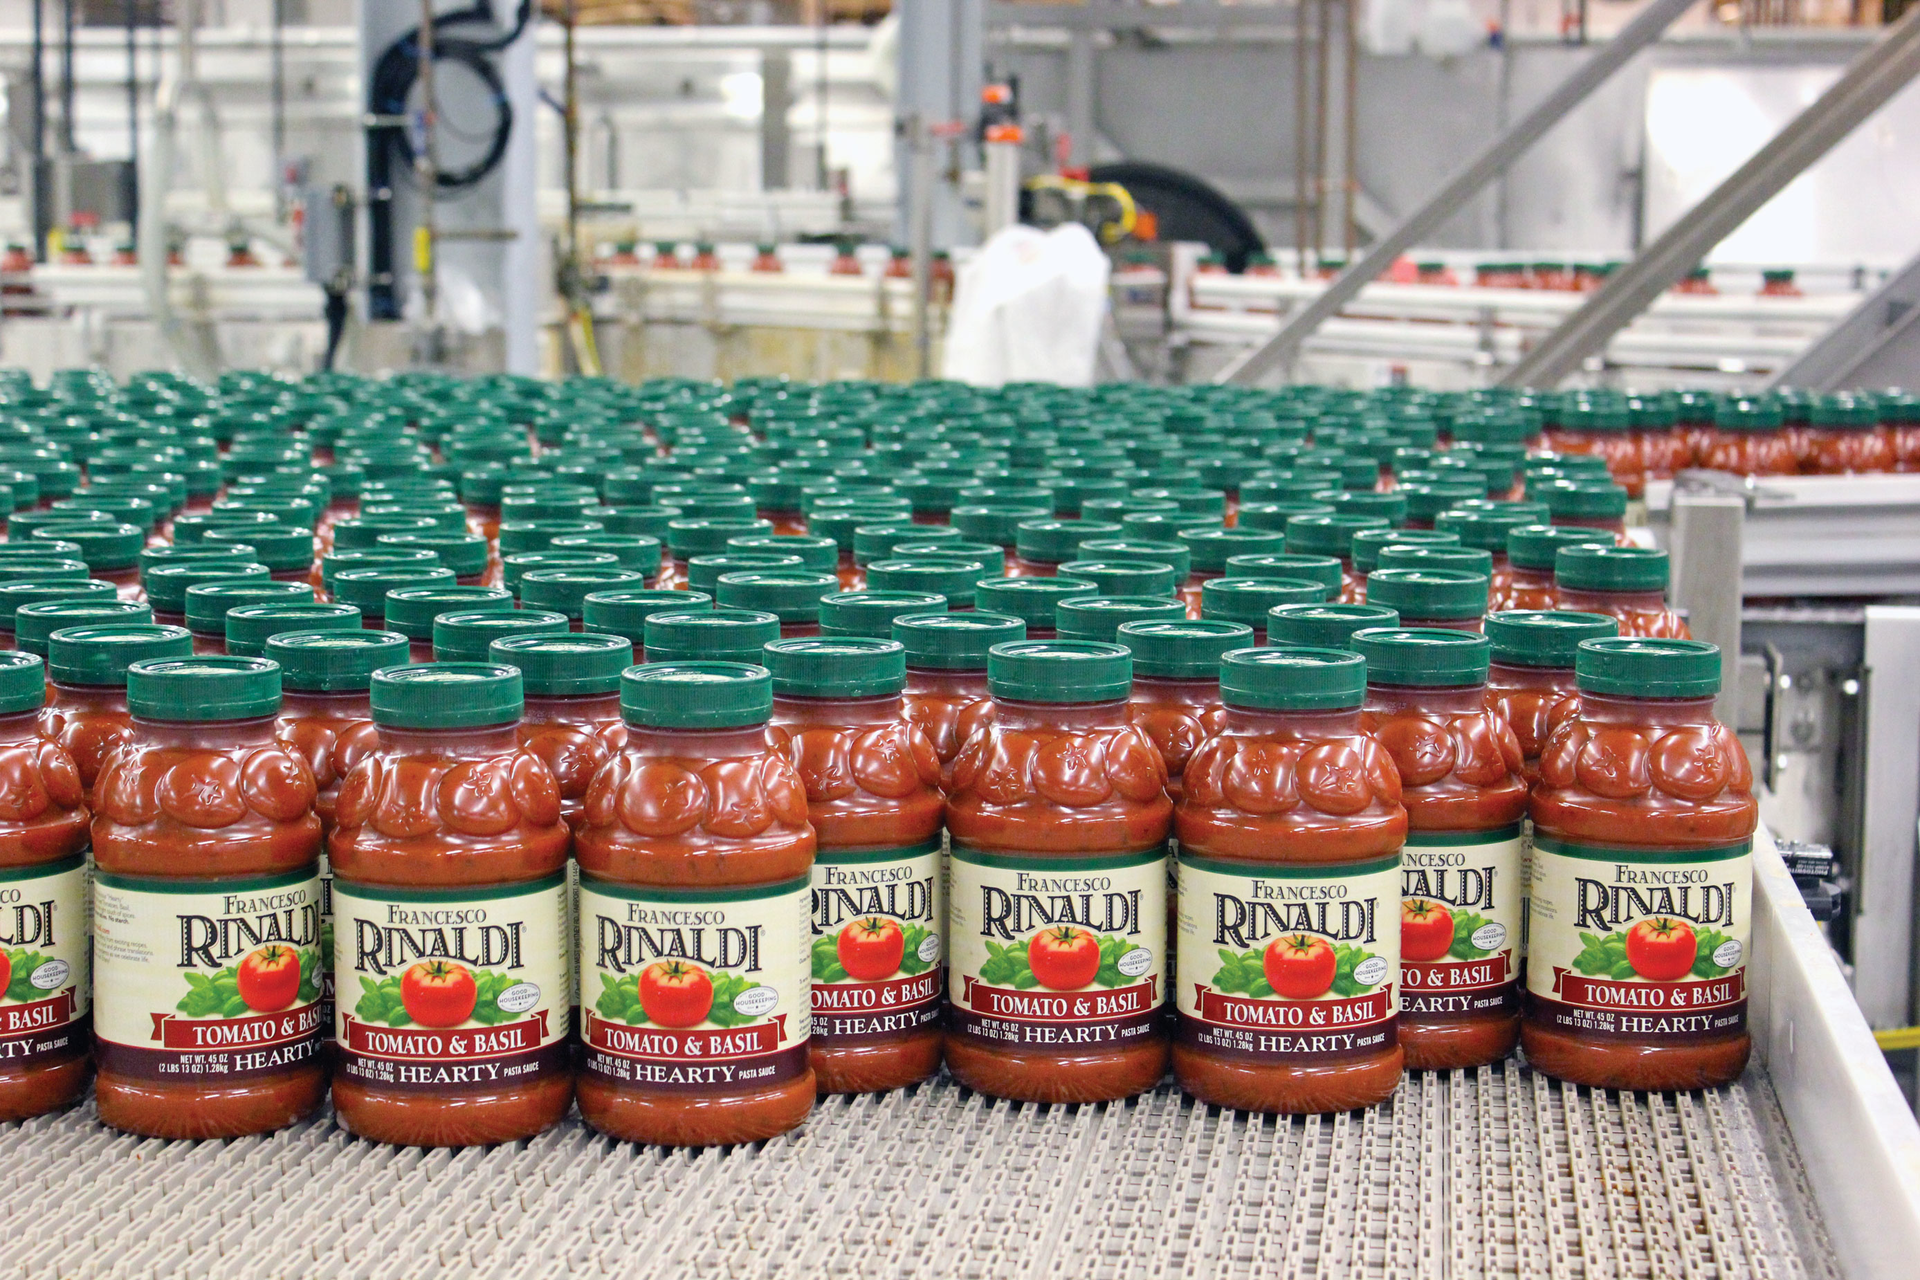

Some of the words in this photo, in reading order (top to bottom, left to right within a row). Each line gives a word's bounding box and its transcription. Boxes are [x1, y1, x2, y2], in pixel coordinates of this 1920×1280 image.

[1402, 853, 1465, 866] NCESCO
[824, 866, 912, 884] FRANCESCO
[1016, 872, 1111, 892] FRANCESCO
[1615, 865, 1708, 883] FRANCESCO
[1252, 880, 1347, 899] FRANCESCO
[223, 890, 306, 915] FRANCESCO
[980, 885, 1141, 940] RINALDI
[1574, 877, 1734, 931] RINALDI
[387, 904, 486, 924] FRANCESCO
[627, 903, 725, 925] FRANCESCO
[1213, 893, 1377, 948] RINALDI
[177, 899, 320, 968] RINALDI
[354, 918, 524, 975] RINALDI
[596, 915, 762, 973] RINALDI
[1427, 969, 1444, 986] &
[1450, 965, 1493, 985] BASIL
[811, 989, 875, 1008] OMATO
[881, 986, 897, 1004] &
[902, 978, 933, 1001] BASIL
[1584, 984, 1664, 1006] TOMATO
[1670, 988, 1687, 1006] &
[1692, 983, 1732, 1004] BASIL
[990, 994, 1067, 1016] TOMATO
[1074, 998, 1090, 1016] &
[1097, 992, 1140, 1014] BASIL
[1224, 1002, 1302, 1025] TOMATO
[1309, 1007, 1326, 1024] &
[1332, 1001, 1376, 1023] BASIL
[1400, 996, 1472, 1012] EARTY
[1474, 999, 1488, 1009] PASTA
[1490, 996, 1502, 1006] SAUCE
[8, 1005, 57, 1029] BASIL
[833, 1011, 919, 1034] HEARTY
[982, 1019, 991, 1028] NET
[992, 1021, 1000, 1030] WT.
[1002, 1022, 1009, 1031] 45
[1011, 1023, 1018, 1032] OZ
[1562, 1016, 1572, 1026] LBS
[1574, 1017, 1581, 1027] 13
[1582, 1018, 1592, 1028] OZ)
[1594, 1020, 1614, 1031] 1.28kg
[1573, 1009, 1584, 1018] NET
[1585, 1011, 1595, 1020] WT.
[1597, 1012, 1605, 1021] 45
[1607, 1013, 1614, 1022] OZ
[1620, 1014, 1713, 1032] HEARTY
[1715, 1018, 1727, 1028] PASTA
[1728, 1014, 1738, 1026] SAUCE
[193, 1020, 276, 1045] TOMATO
[281, 1017, 295, 1036] &
[811, 1027, 828, 1036] .28kg
[973, 1025, 981, 1036] LBS
[982, 1028, 987, 1037] 13
[989, 1028, 998, 1039] OZ)
[1000, 1030, 1019, 1042] 1.28kg
[1024, 1024, 1119, 1043] HEARTY
[1122, 1028, 1135, 1038] PASTA
[1137, 1023, 1149, 1034] SAUCE
[1213, 1028, 1223, 1037] NET
[1224, 1029, 1233, 1038] WT.
[1235, 1031, 1243, 1039] 45
[1246, 1032, 1253, 1041] OZ
[37, 1040, 53, 1052] PASTA
[54, 1037, 68, 1048] SAUCE
[366, 1032, 442, 1055] TOMATO
[450, 1035, 467, 1054] &
[474, 1029, 526, 1052] BASIL
[605, 1028, 678, 1055] TOMATO
[684, 1036, 703, 1054] &
[710, 1032, 762, 1054] BASIL
[1204, 1035, 1212, 1044] LBS
[1215, 1037, 1220, 1045] 13
[1221, 1038, 1231, 1048] OZ)
[1233, 1039, 1253, 1051] 1.28kg
[1259, 1034, 1355, 1053] HEARTY
[1357, 1038, 1371, 1047] PASTA
[1372, 1033, 1384, 1044] SAUCE
[181, 1055, 193, 1064] NET
[195, 1055, 206, 1063] WT.
[208, 1054, 217, 1063] 45
[220, 1054, 228, 1062] OZ
[234, 1039, 314, 1071] HEARTY
[358, 1058, 367, 1067] NET
[368, 1059, 376, 1069] WT.
[378, 1061, 384, 1070] 45
[386, 1062, 393, 1071] OZ
[597, 1053, 606, 1064] NET
[615, 1058, 621, 1068] 45
[623, 1060, 630, 1069] OZ
[159, 1064, 165, 1073] (2
[167, 1064, 179, 1073] LBS
[182, 1064, 190, 1073] 13
[192, 1064, 203, 1073] OZ)
[206, 1064, 228, 1073] 1.28kg
[359, 1067, 364, 1076] 13
[365, 1068, 374, 1078] OZ)
[375, 1069, 394, 1083] 1.28kg
[400, 1063, 500, 1083] HEARTY
[504, 1067, 521, 1077] PASTA
[523, 1062, 539, 1073] SAUCE
[599, 1064, 603, 1072] 13
[604, 1065, 612, 1076] OZ)
[613, 1066, 630, 1080] 1.28kg
[635, 1064, 736, 1083] HEARTY
[739, 1069, 757, 1080] PASTA
[759, 1066, 775, 1076] SAUCE
